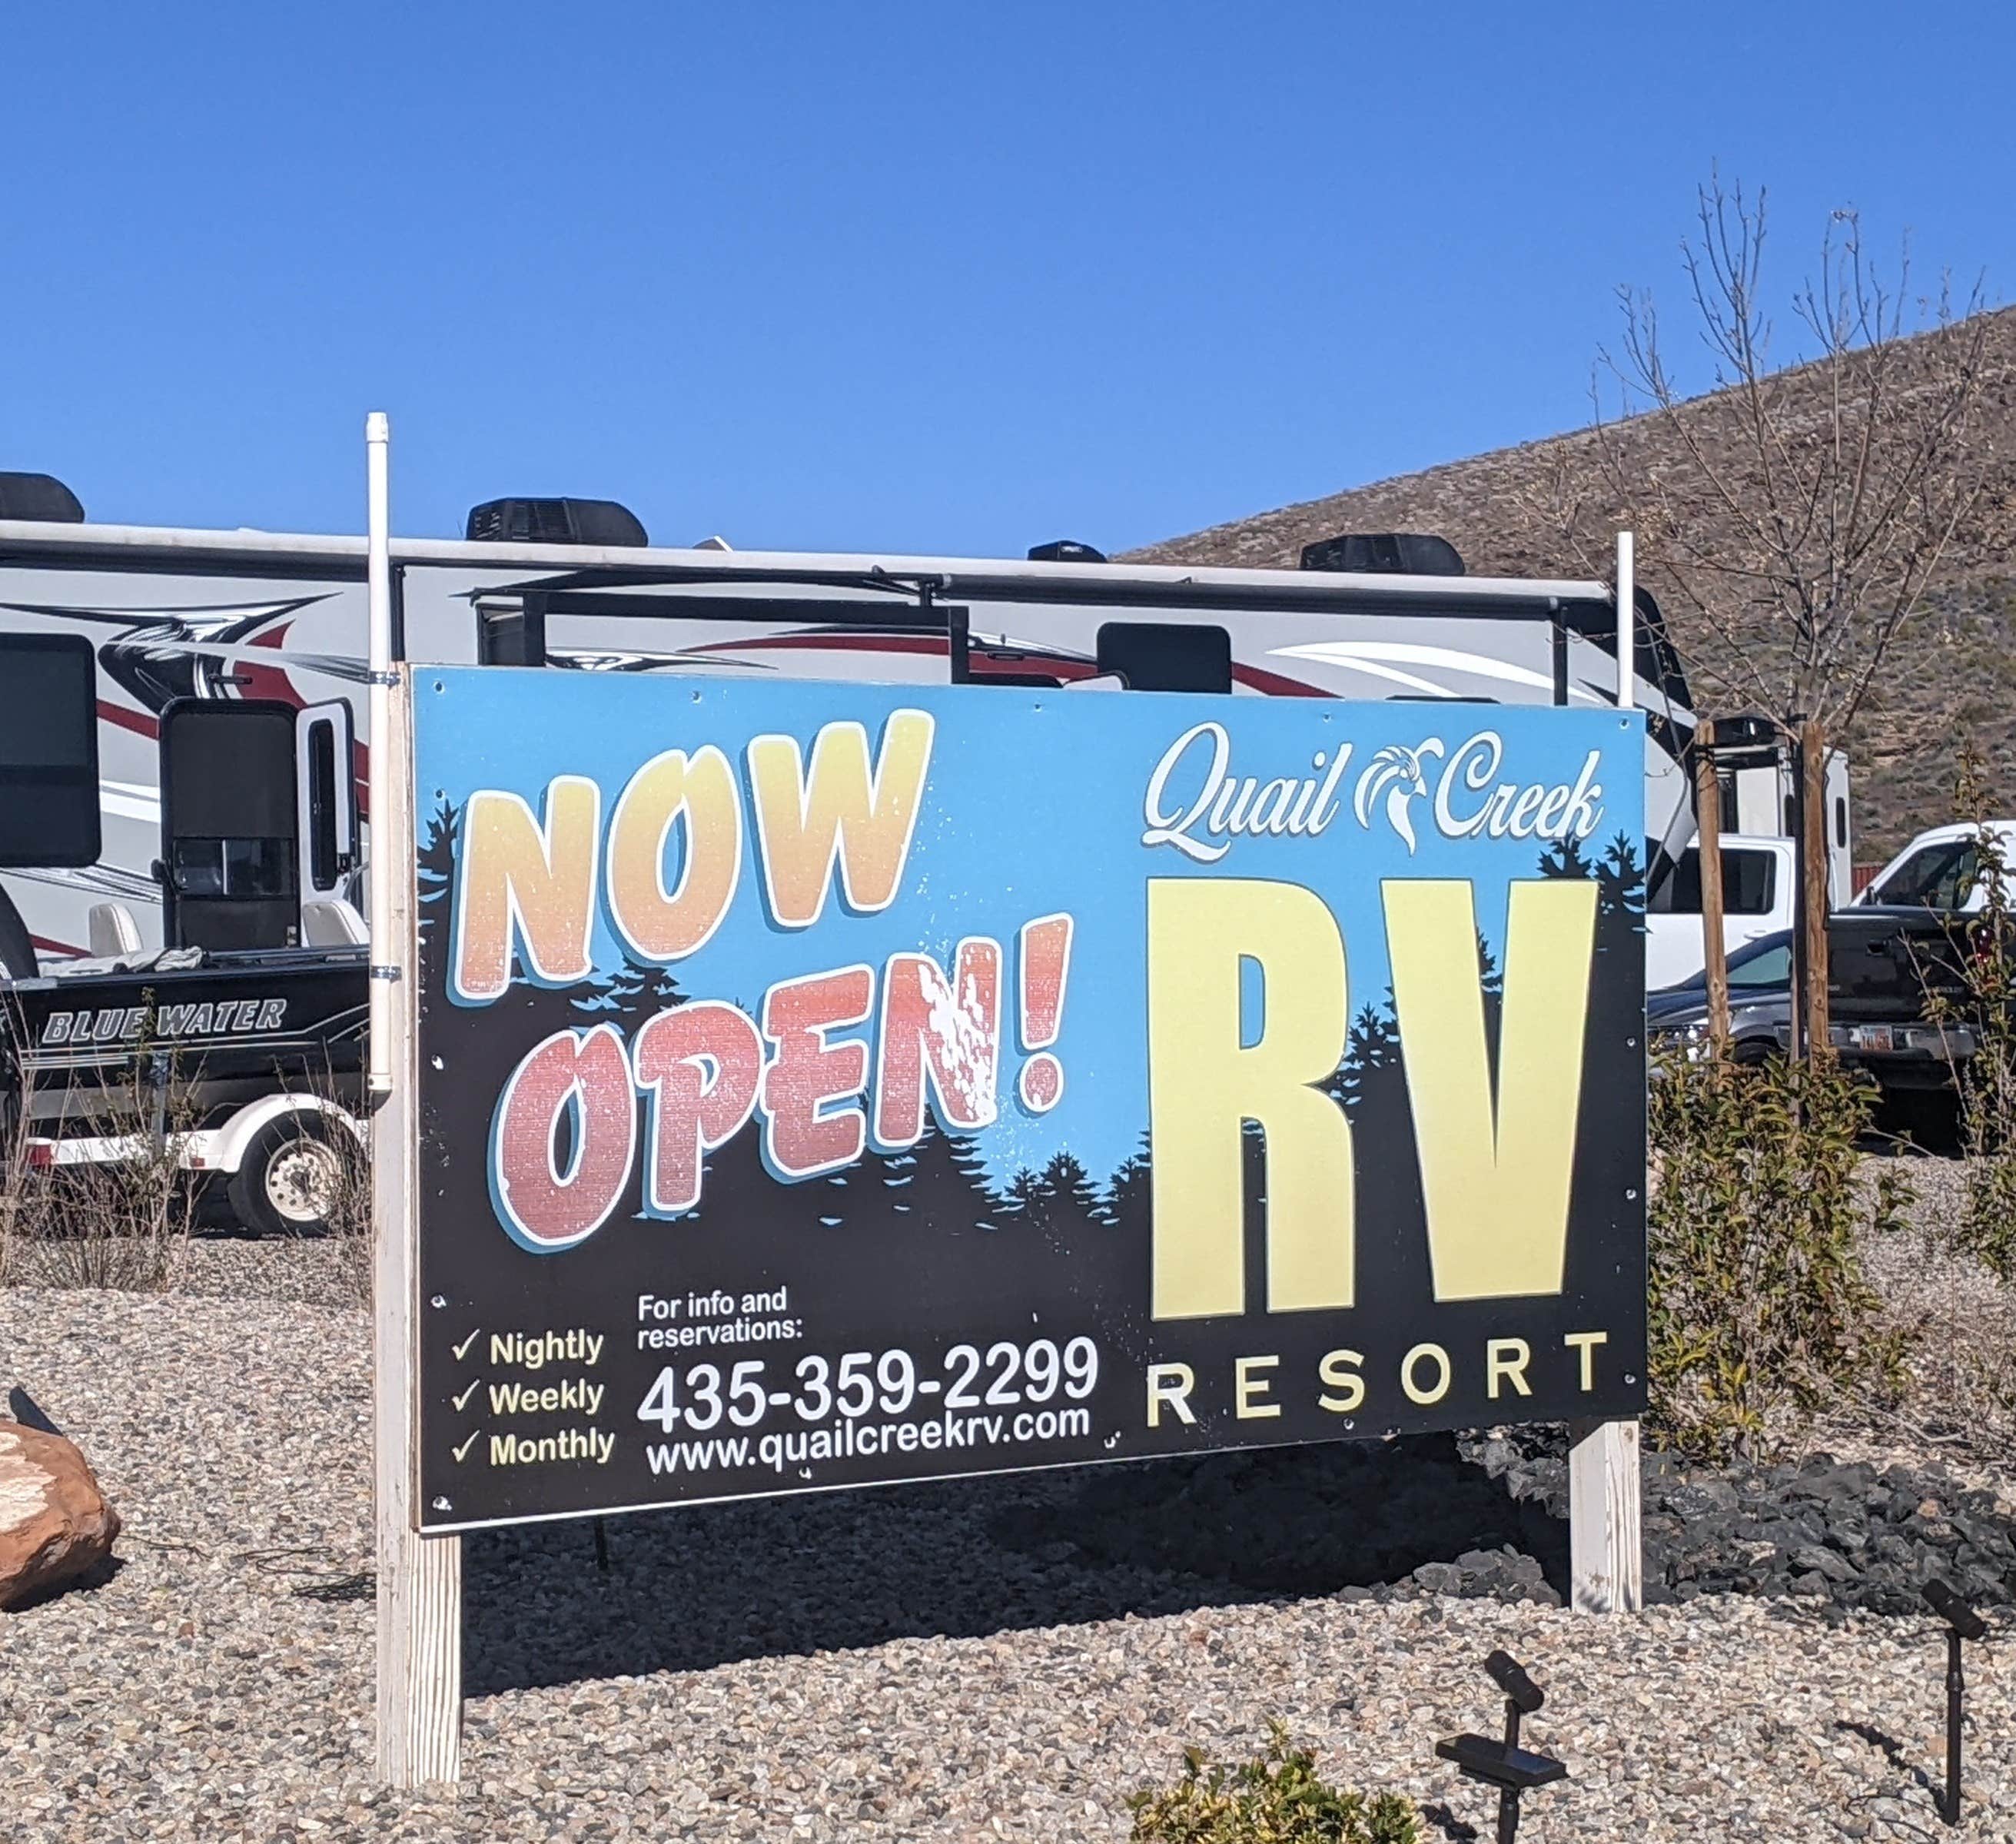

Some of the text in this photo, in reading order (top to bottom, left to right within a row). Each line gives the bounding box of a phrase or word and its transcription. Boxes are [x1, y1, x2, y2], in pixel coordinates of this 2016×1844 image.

[1142, 721, 1603, 861] Quail Creek
[453, 708, 935, 999] NOW
[42, 998, 287, 1043] BLUE WATER
[493, 912, 1074, 1246] OPEN!
[1146, 876, 1599, 1321] RV
[637, 1317, 803, 1350] reservations:
[638, 1285, 787, 1321] For info and
[490, 1328, 604, 1370] Nightly
[1146, 1331, 1607, 1427] RESORT
[489, 1377, 605, 1415] Weekly
[636, 1336, 1098, 1434] 435-359-2299
[490, 1427, 616, 1466] Monthly
[646, 1408, 1090, 1475] www.quailcreekrv.com
